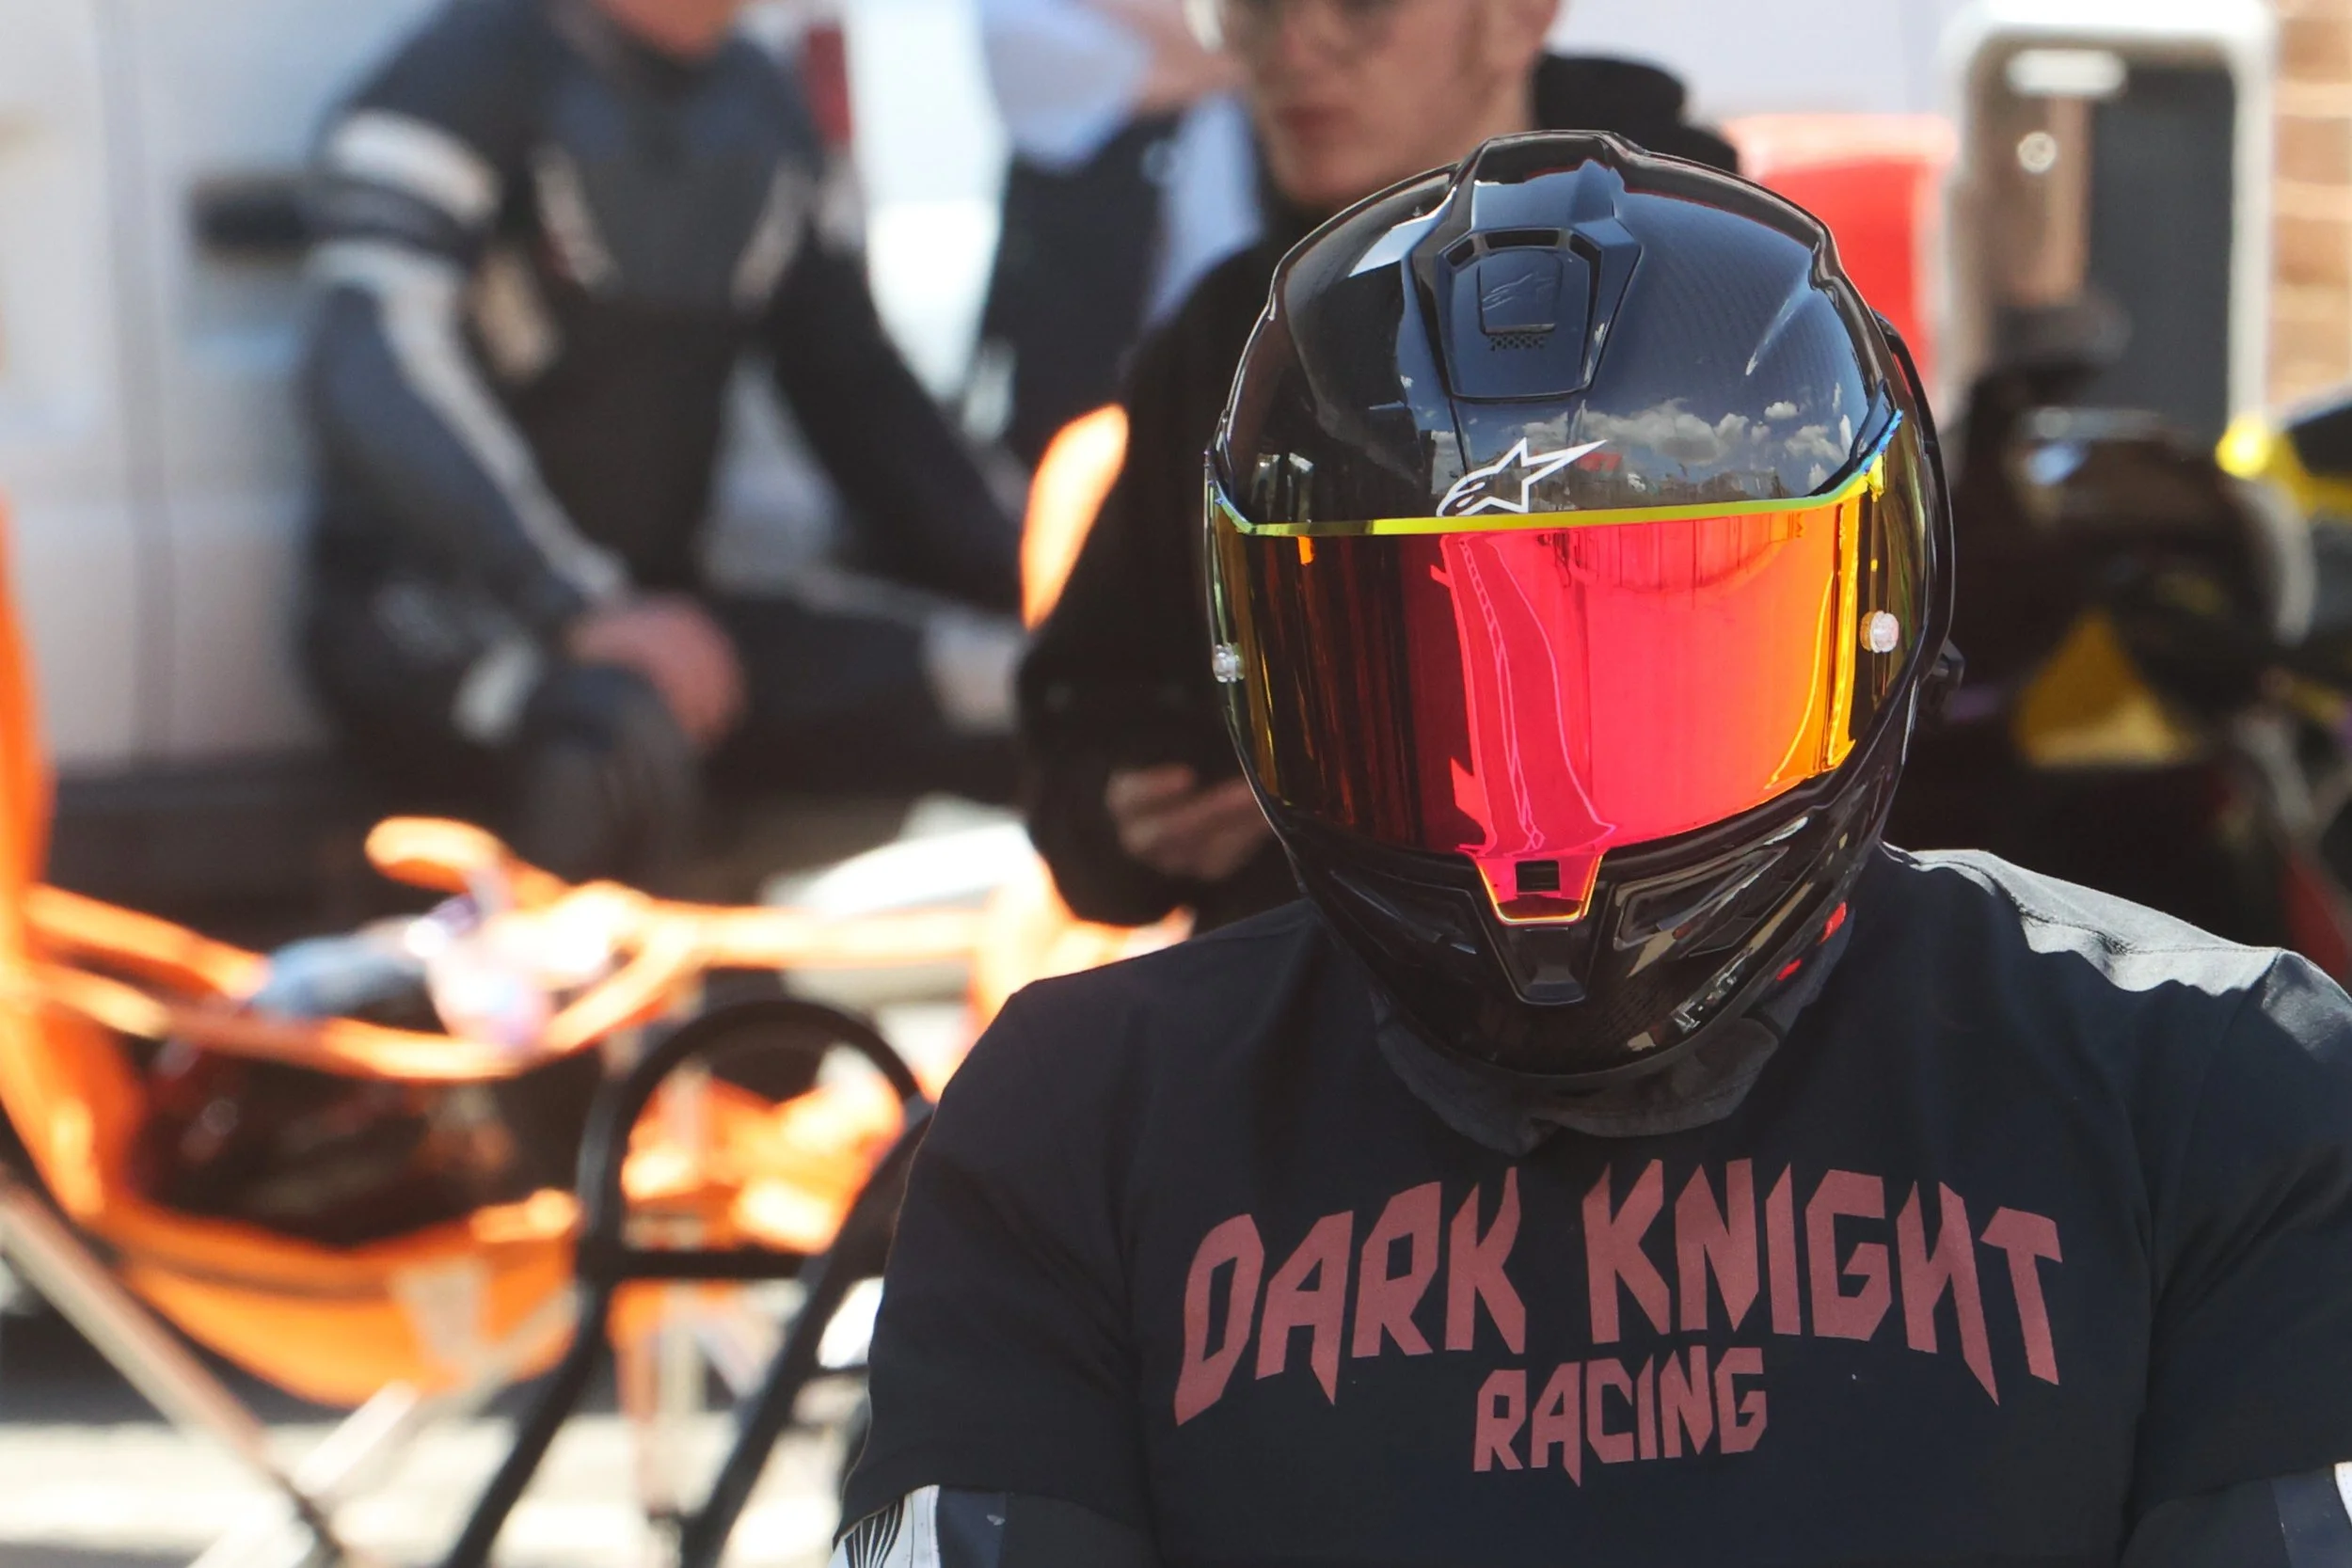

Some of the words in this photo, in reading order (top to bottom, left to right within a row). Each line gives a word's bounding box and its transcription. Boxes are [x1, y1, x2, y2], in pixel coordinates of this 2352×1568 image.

[1174, 1165, 1526, 1426] DARK
[1581, 1158, 2063, 1406] KNIGHT
[1472, 1345, 1768, 1487] RACING
